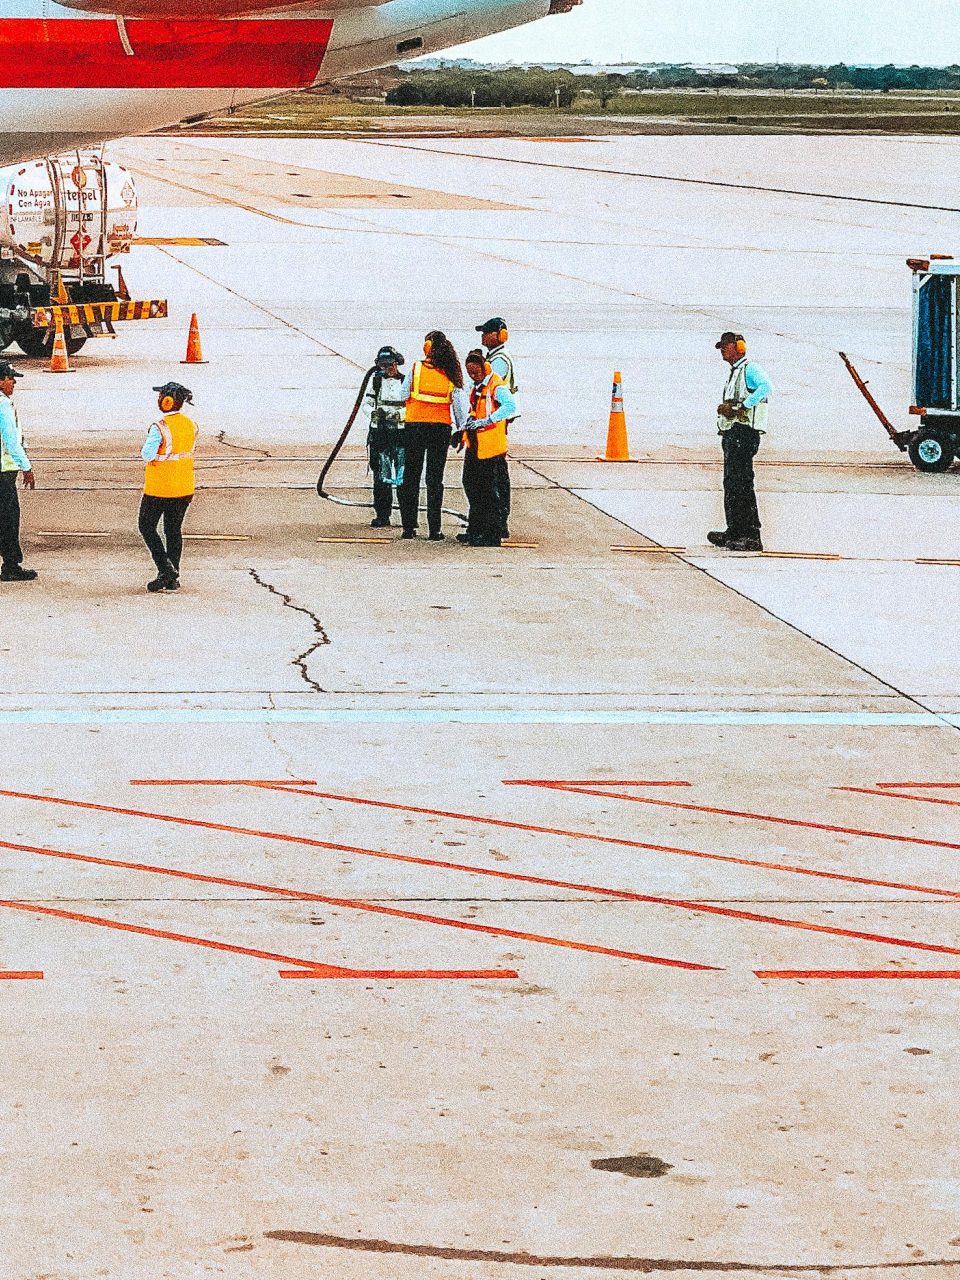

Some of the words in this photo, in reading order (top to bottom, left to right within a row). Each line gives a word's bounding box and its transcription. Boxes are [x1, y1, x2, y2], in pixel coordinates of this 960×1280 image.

[17, 189, 27, 197] No
[29, 189, 53, 198] Apagar
[34, 199, 51, 208] Agua
